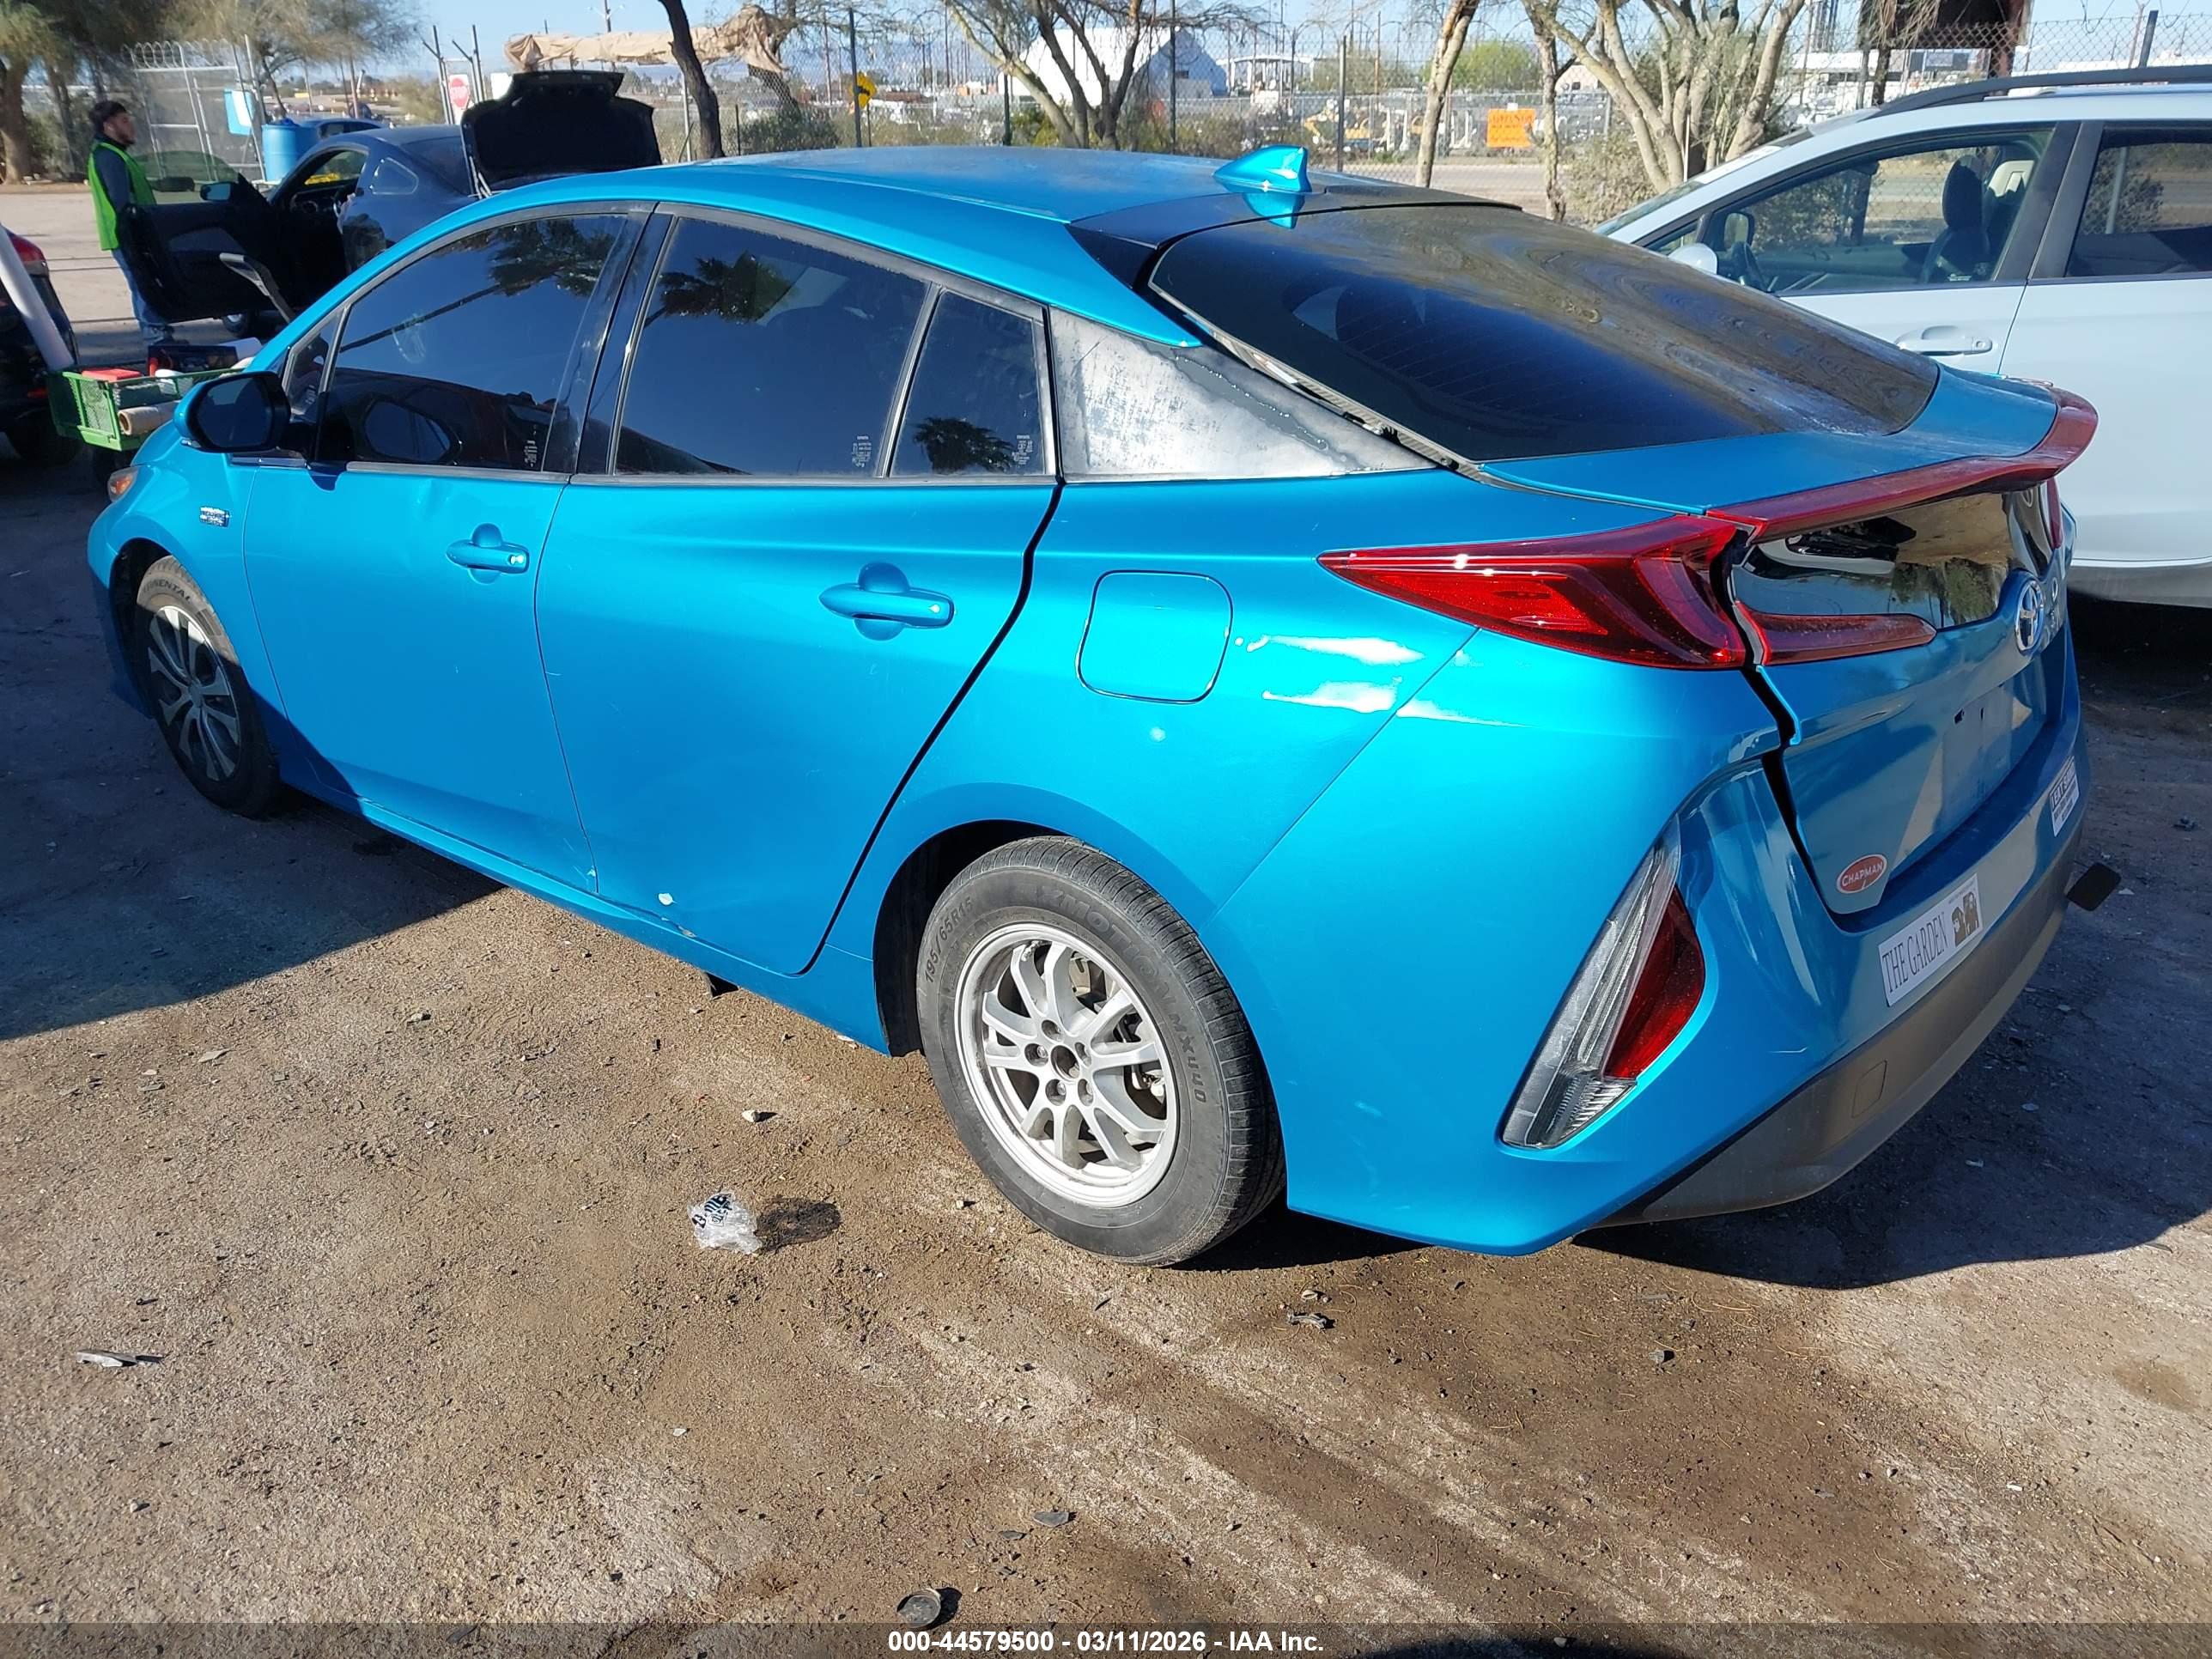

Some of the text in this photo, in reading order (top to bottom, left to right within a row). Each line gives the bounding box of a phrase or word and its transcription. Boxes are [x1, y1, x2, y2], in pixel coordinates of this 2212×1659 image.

[1842, 860, 1883, 886] CHAPMAN
[925, 896, 973, 983] 195/65R15
[1882, 912, 1948, 993] THE GARDEN
